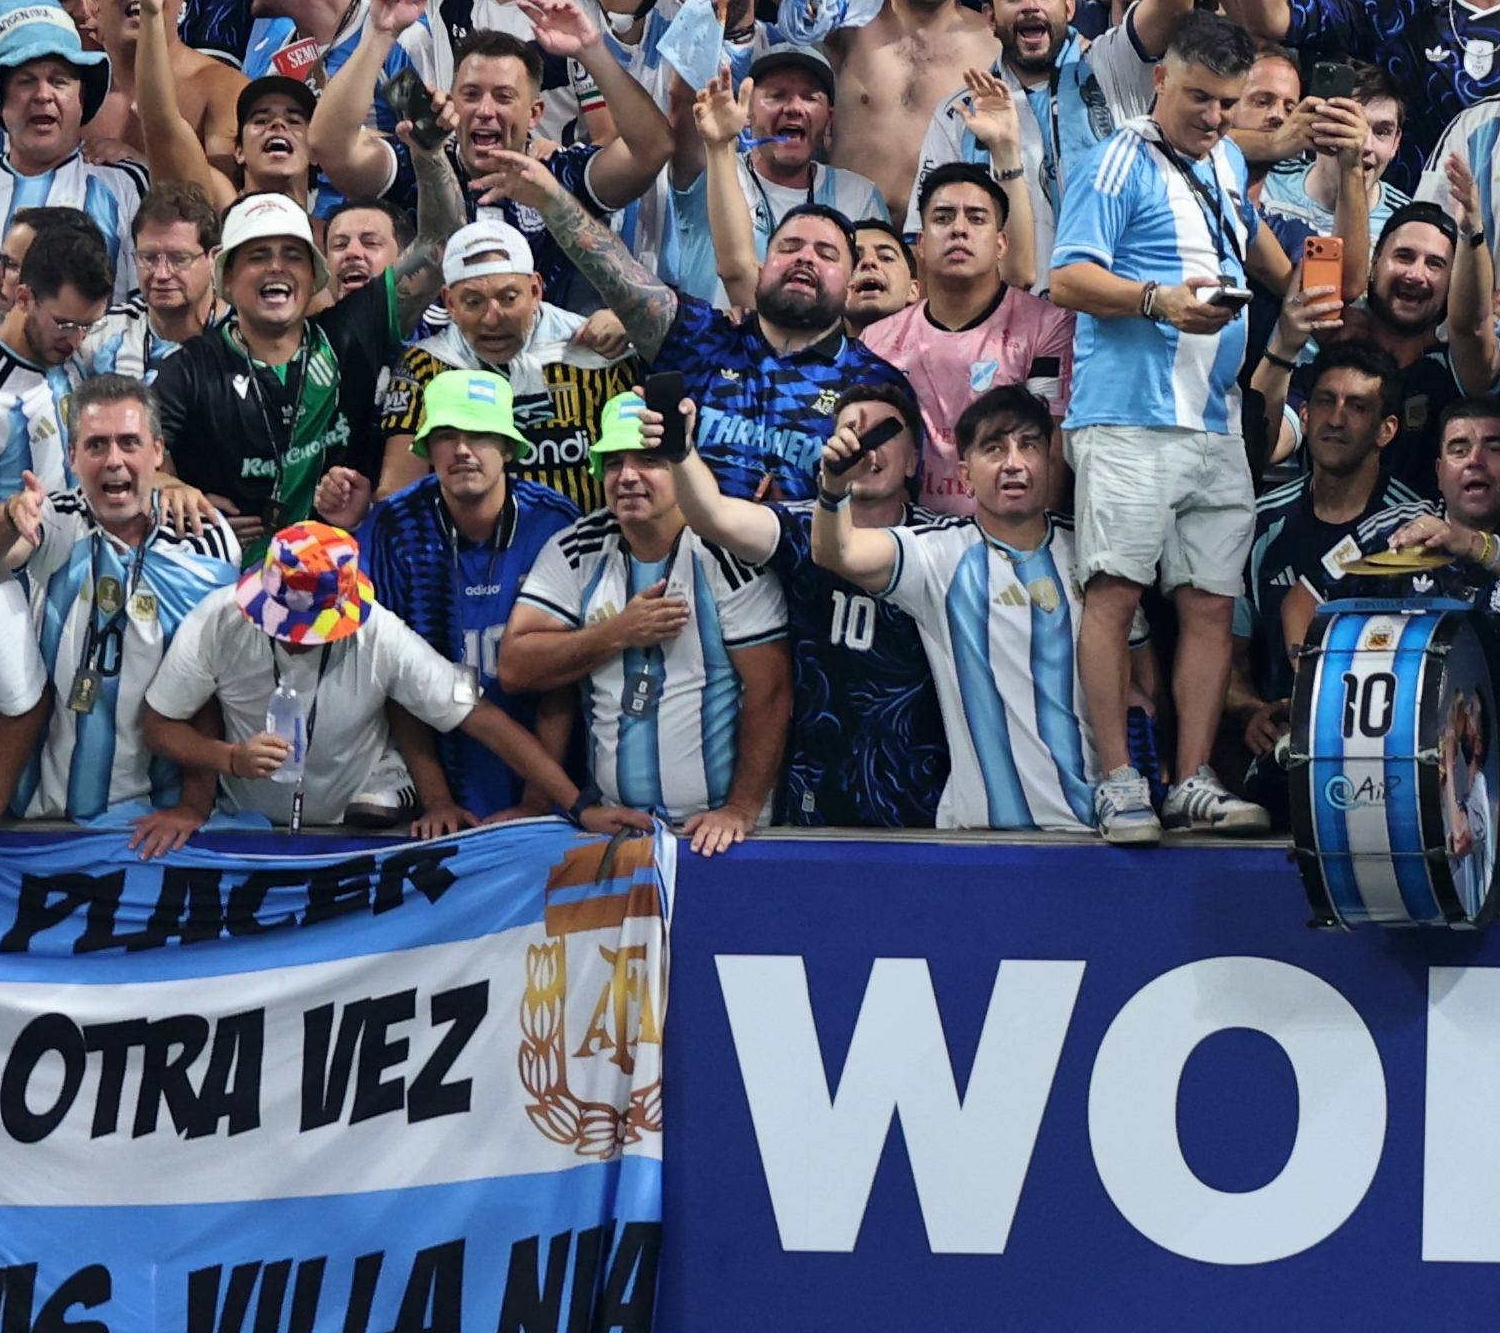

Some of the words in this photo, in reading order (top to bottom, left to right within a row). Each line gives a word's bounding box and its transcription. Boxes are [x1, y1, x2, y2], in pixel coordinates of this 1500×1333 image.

[700, 406, 824, 472] THRASHER
[831, 589, 875, 651] 10
[1342, 670, 1395, 740] 10
[0, 1006, 266, 1145] OTRA
[300, 979, 490, 1134] VEZ
